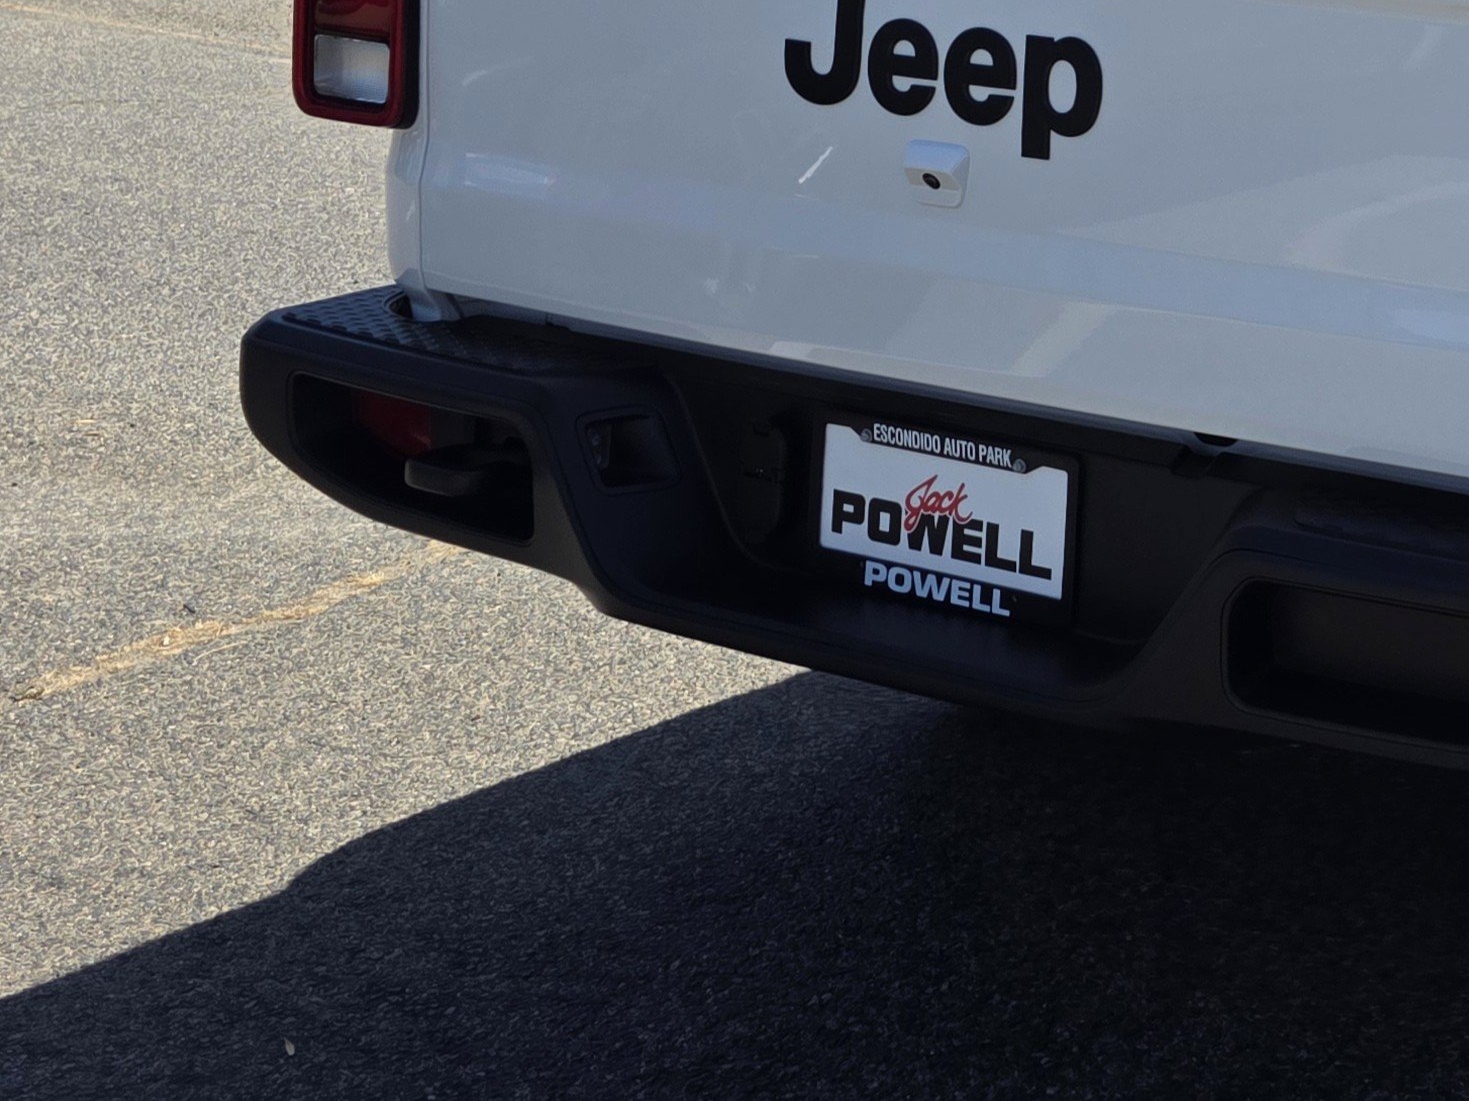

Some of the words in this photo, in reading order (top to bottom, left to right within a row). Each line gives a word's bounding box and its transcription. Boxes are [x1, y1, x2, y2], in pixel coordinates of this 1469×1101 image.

[873, 422, 941, 455] ESCONDIDO
[943, 438, 976, 461] AUTO
[978, 444, 1013, 469] PARK
[904, 474, 973, 533] Jack
[831, 488, 1052, 582] POWELL
[863, 560, 1011, 618] POWELL
